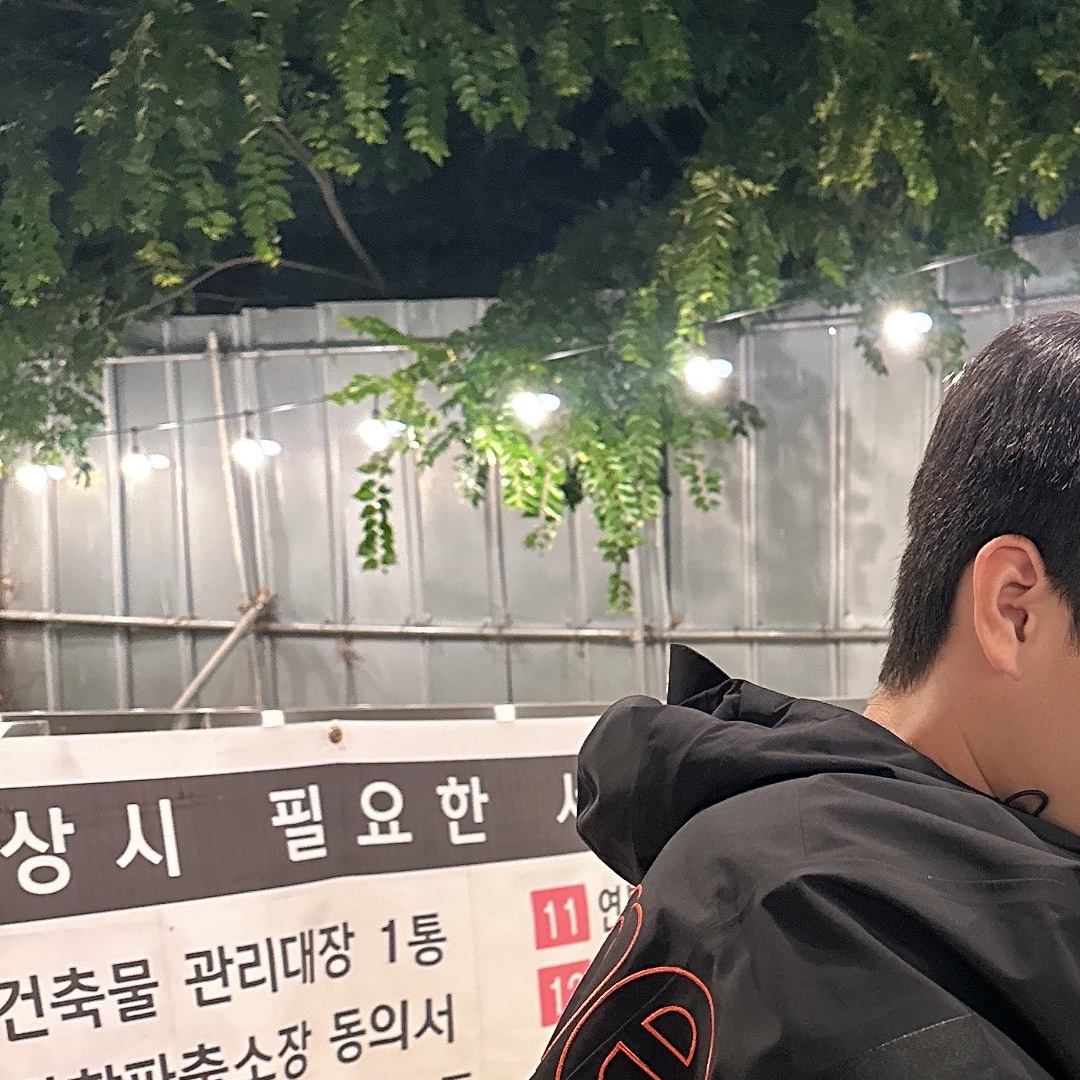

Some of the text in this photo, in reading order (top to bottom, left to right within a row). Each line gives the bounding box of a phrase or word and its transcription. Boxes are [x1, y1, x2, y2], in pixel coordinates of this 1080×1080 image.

[268, 776, 488, 862] 필요한
[543, 898, 582, 941] 11
[0, 912, 447, 1041] 건축물 관리대장 1통
[330, 994, 455, 1063] 동의서
